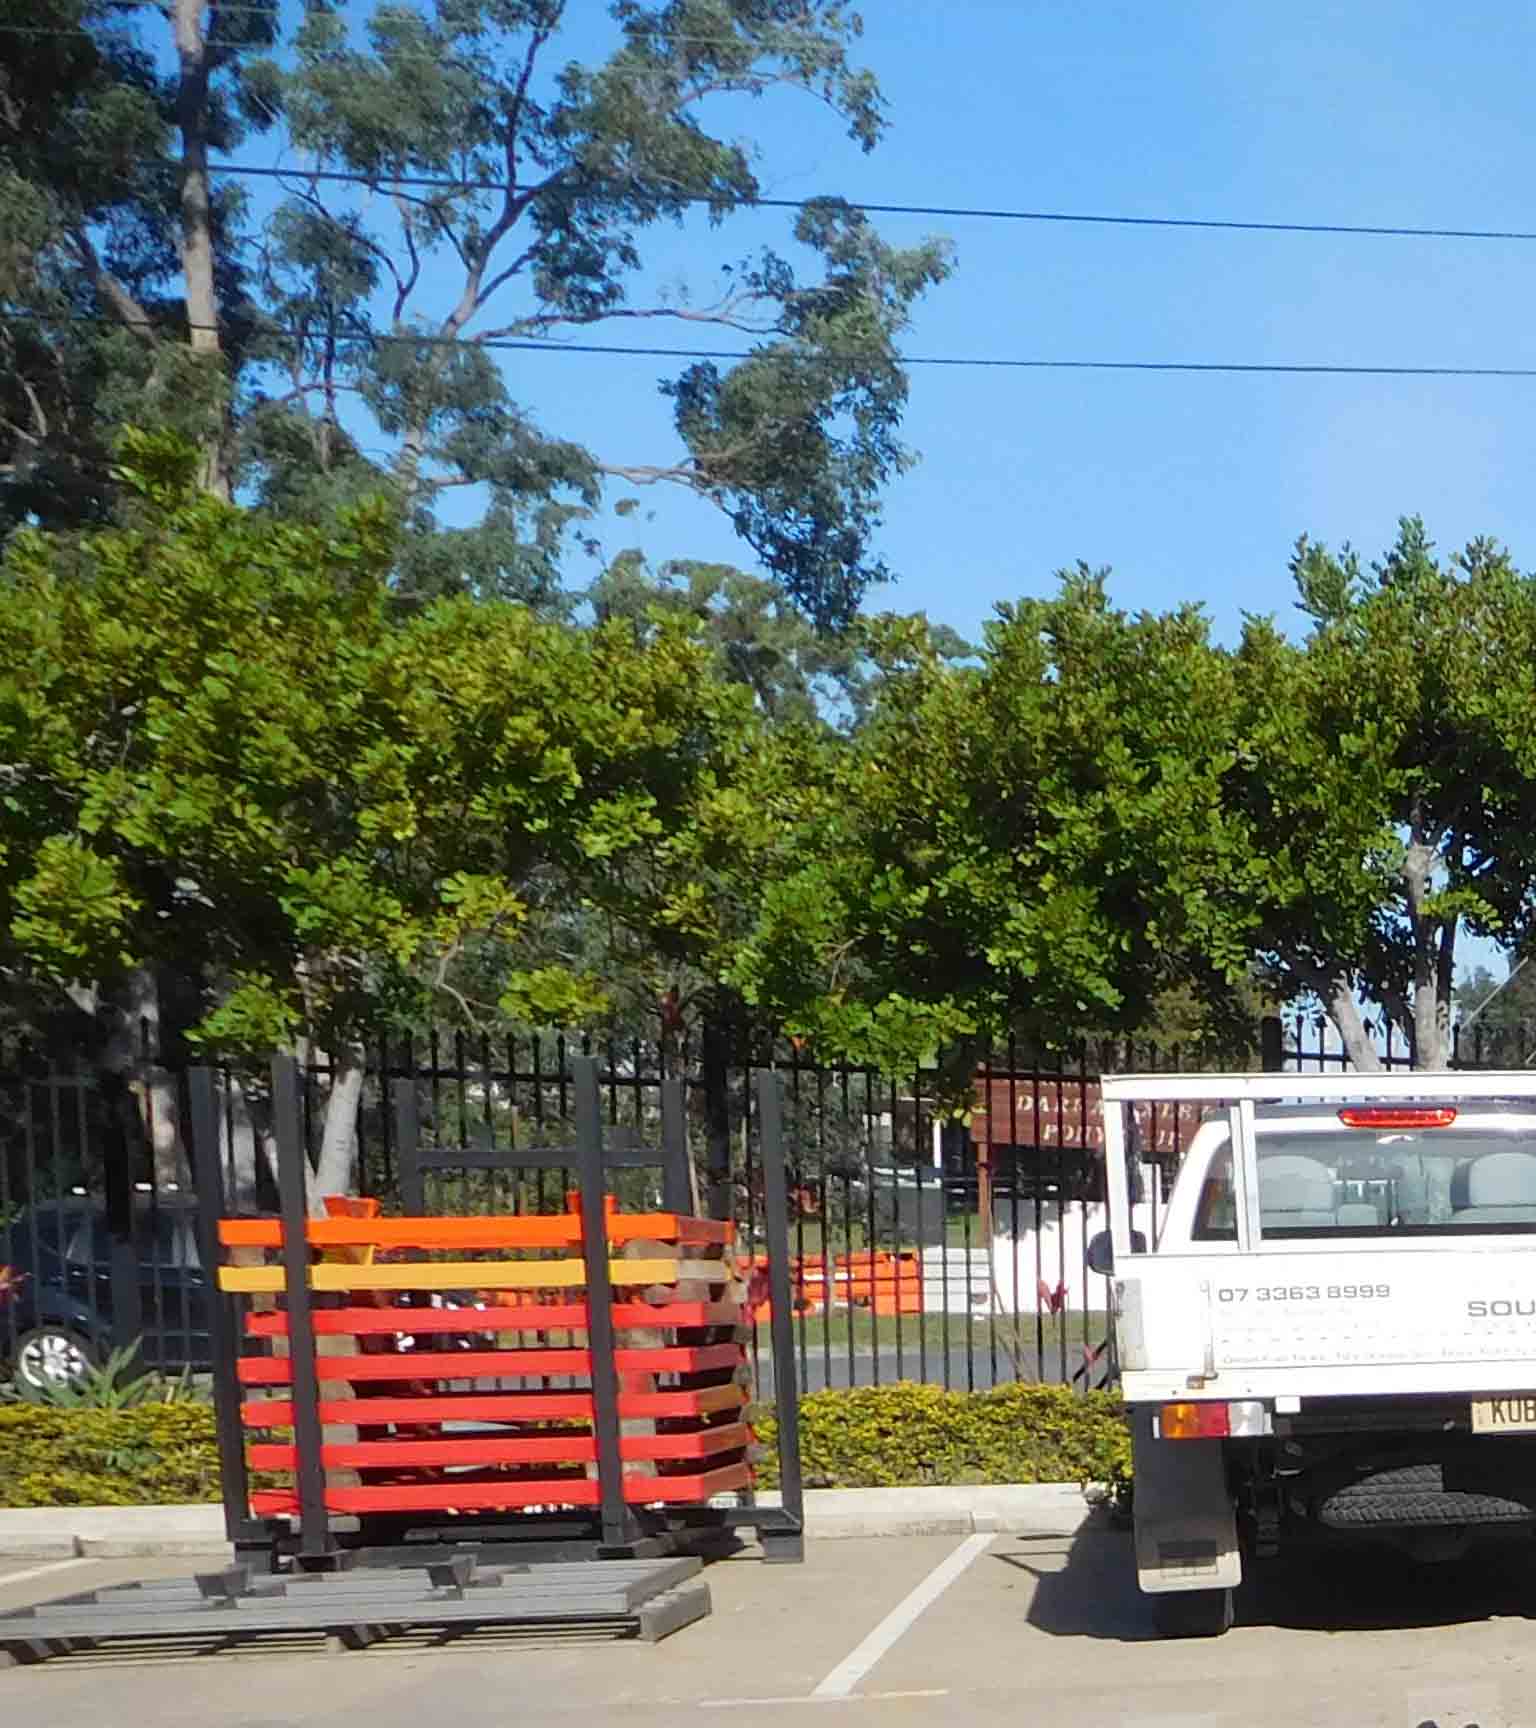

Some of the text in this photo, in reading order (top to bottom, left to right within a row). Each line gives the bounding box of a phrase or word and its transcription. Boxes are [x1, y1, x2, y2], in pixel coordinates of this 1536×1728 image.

[1218, 1284, 1390, 1302] 07 3363 8999
